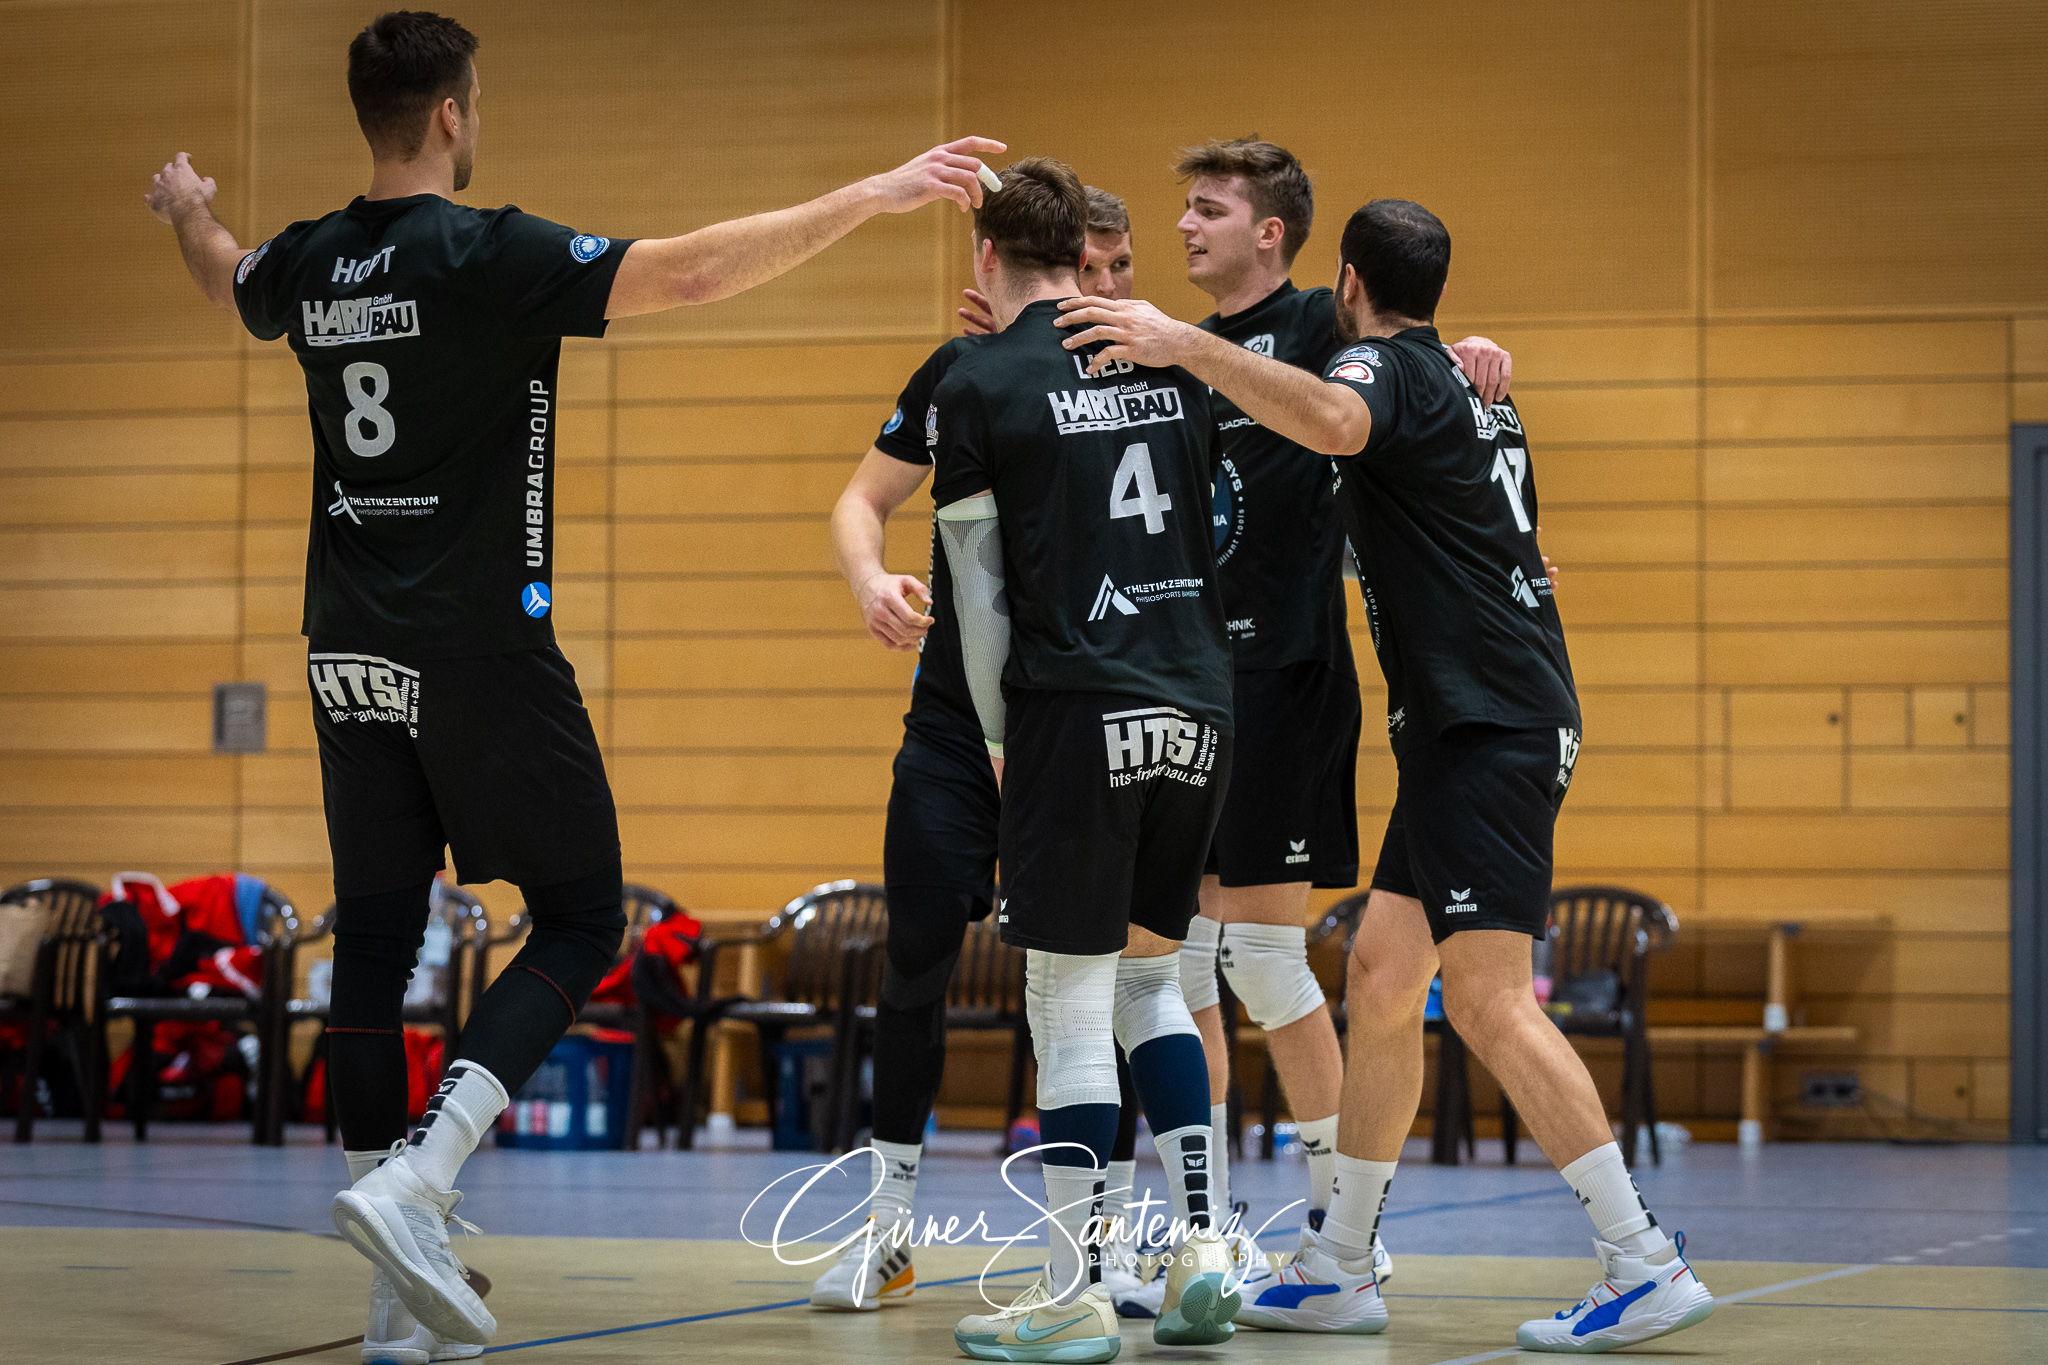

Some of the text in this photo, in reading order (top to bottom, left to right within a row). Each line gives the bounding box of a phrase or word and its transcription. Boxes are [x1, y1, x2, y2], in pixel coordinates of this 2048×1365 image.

[302, 297, 415, 337] HART BAU
[372, 293, 393, 306] GmbH
[1047, 386, 1179, 424] HART BAU
[1120, 381, 1149, 394] GmbH
[343, 362, 396, 457] 8
[526, 379, 549, 568] UMBRAGROUP
[1110, 442, 1172, 534] 4
[1490, 447, 1532, 533] 17
[356, 508, 435, 516] PHYSIOSPORTS BAMBERG
[310, 663, 404, 710] HTS
[1104, 717, 1198, 771] HTS
[1285, 853, 1310, 864] erima
[1445, 902, 1478, 914] erima
